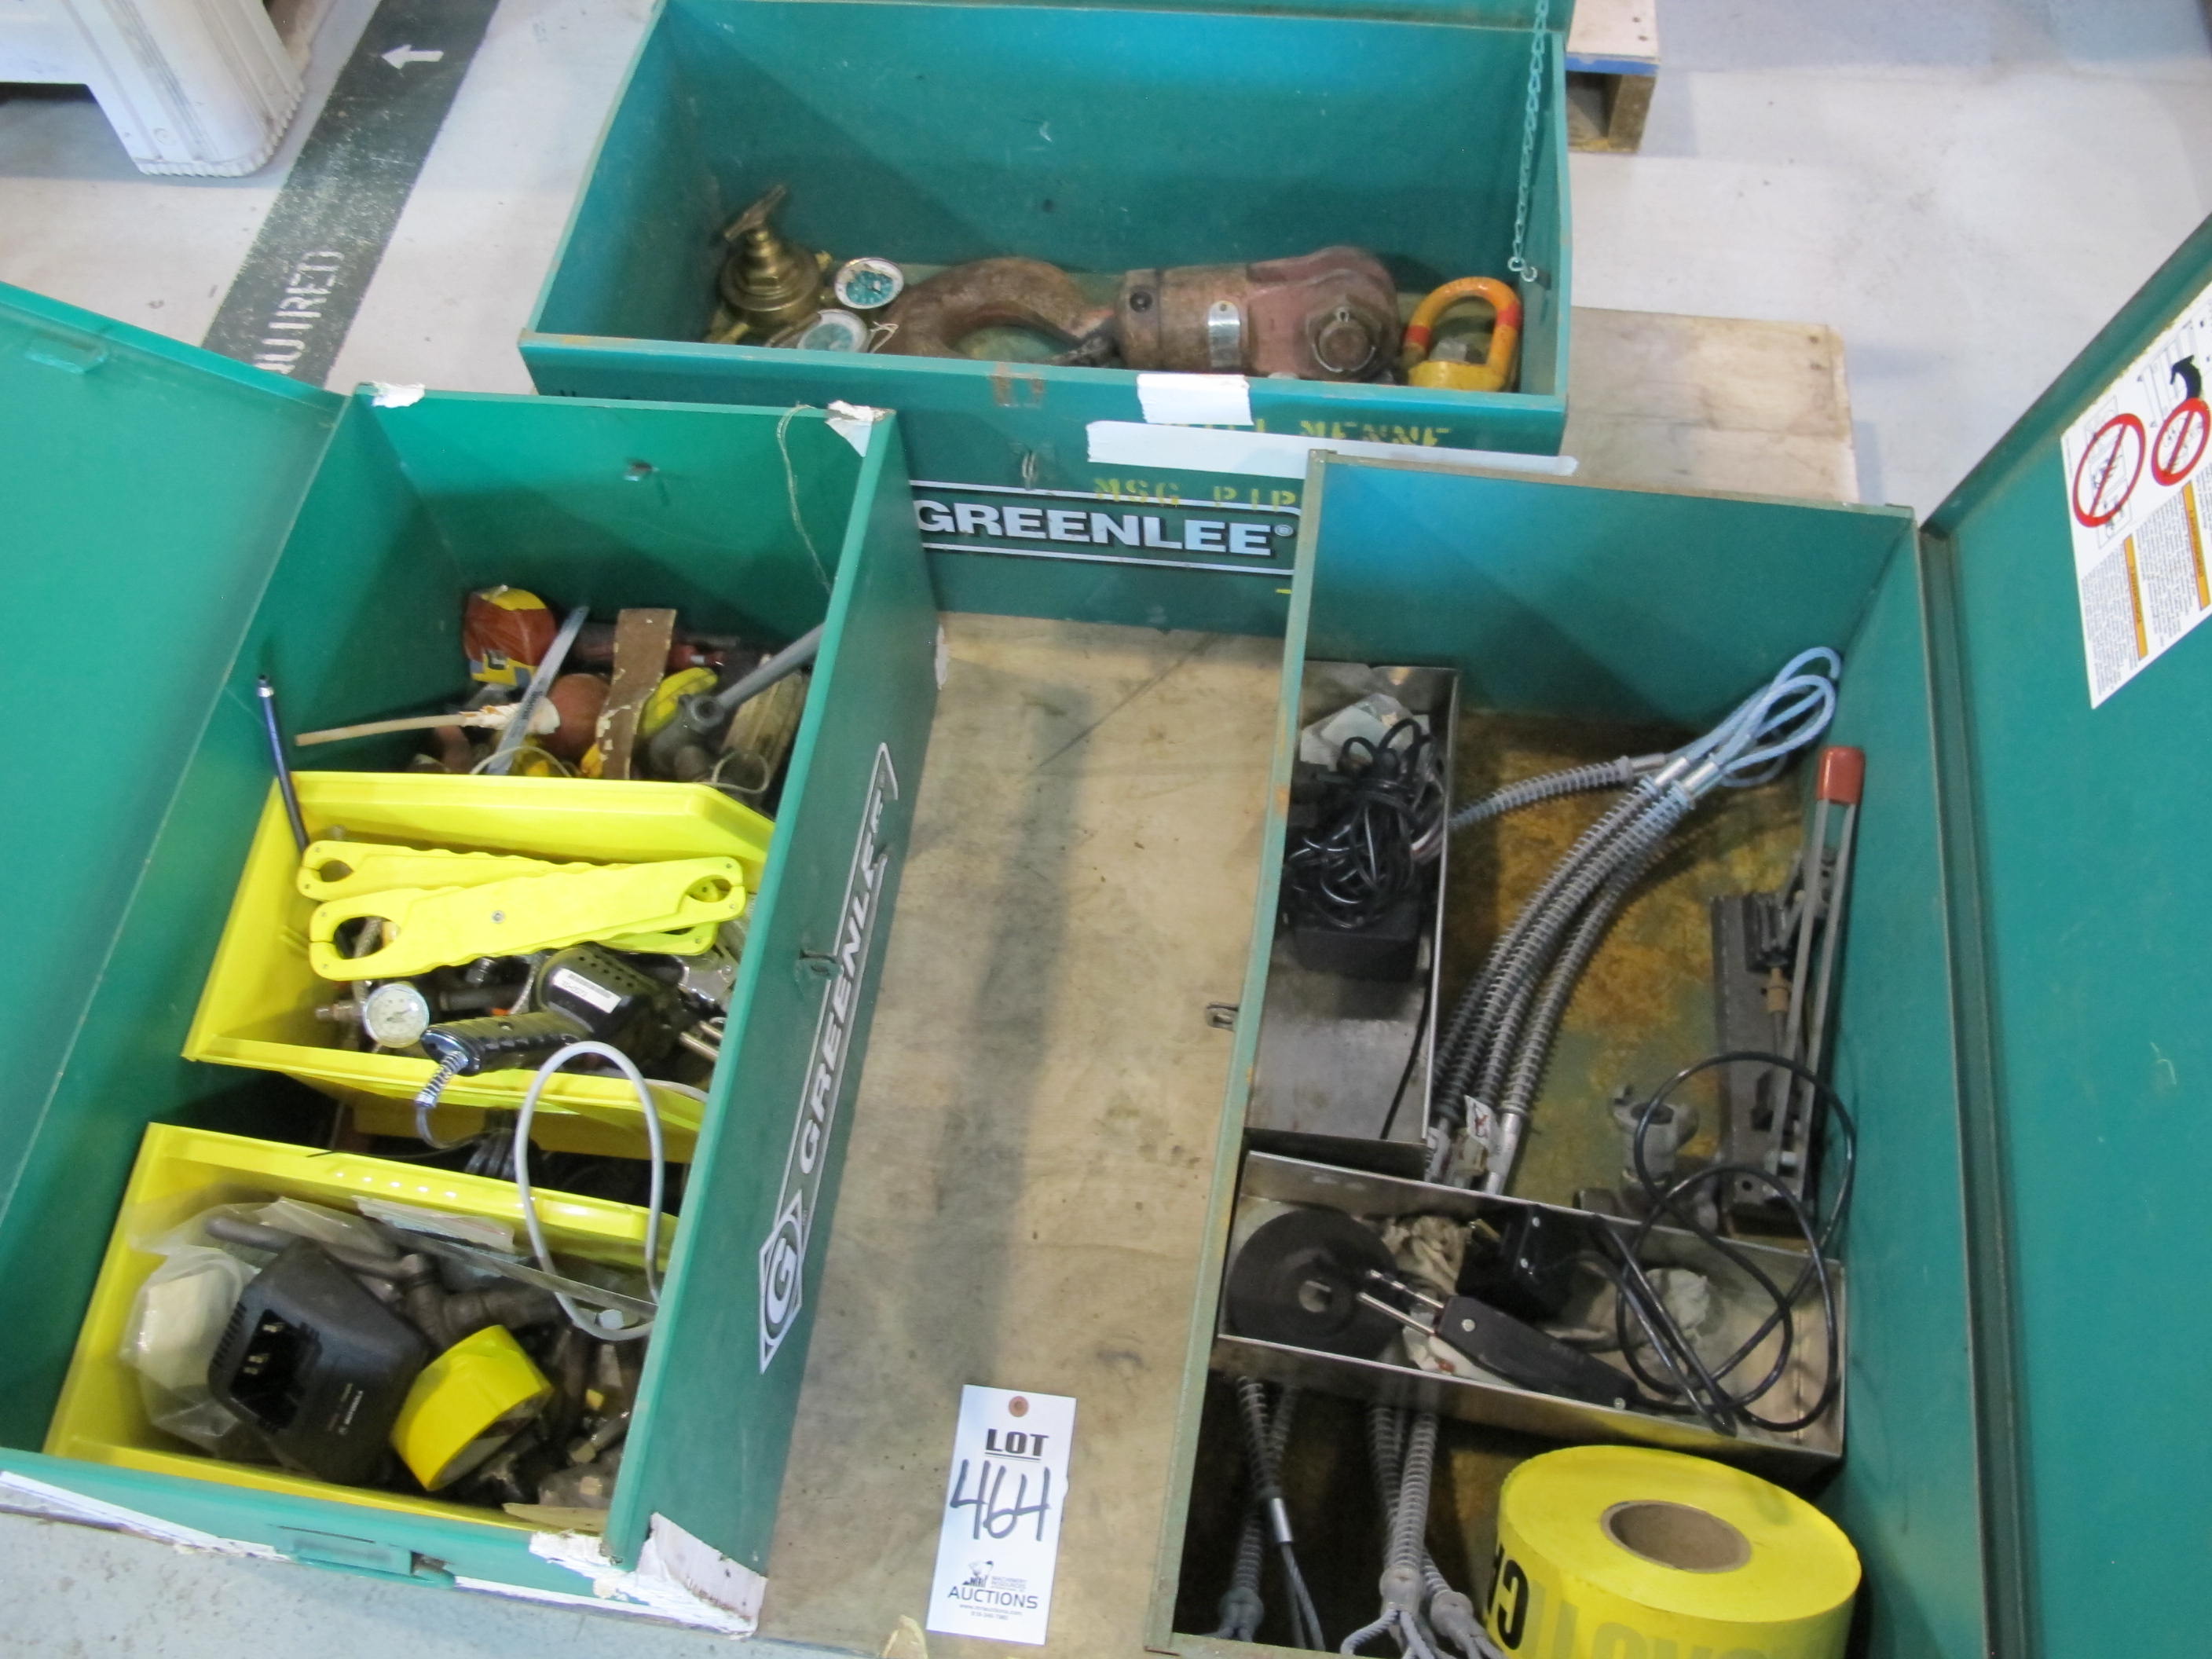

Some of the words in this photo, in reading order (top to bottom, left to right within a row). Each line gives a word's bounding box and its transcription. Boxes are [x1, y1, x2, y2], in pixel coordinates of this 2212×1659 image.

[1095, 478, 1181, 507] MSG
[986, 1428, 1049, 1457] LOT
[949, 1459, 1051, 1542] 464
[947, 1586, 1038, 1610] AUCTIONS
